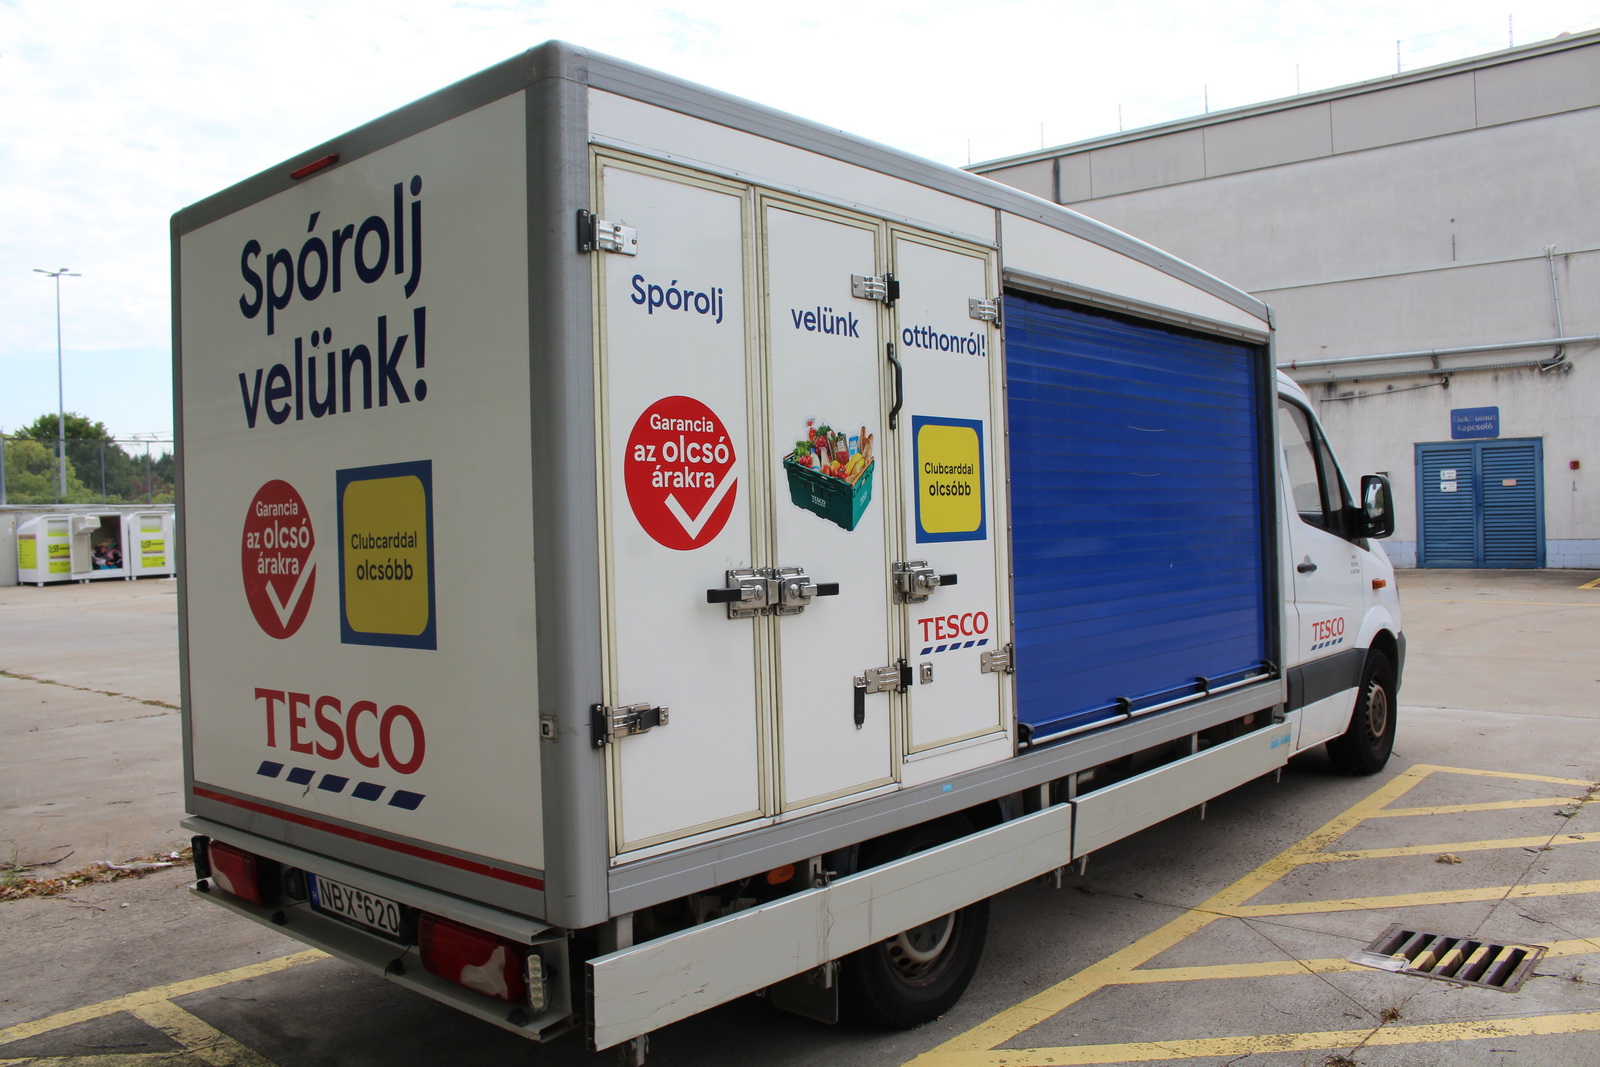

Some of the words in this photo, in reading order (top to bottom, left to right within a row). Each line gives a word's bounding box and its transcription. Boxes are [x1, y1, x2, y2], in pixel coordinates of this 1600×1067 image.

[239, 174, 423, 336] Spórolj
[630, 273, 724, 325] Spórolj
[790, 305, 860, 339] velünk
[902, 325, 986, 358] otthonról!
[238, 306, 427, 429] velünk!
[649, 413, 714, 433] Garancia
[633, 444, 657, 462] az
[662, 434, 730, 464] olcsó
[651, 464, 715, 488] árakra
[924, 461, 974, 475] Clubcarddal
[928, 480, 972, 497] olcsóbb
[255, 499, 299, 517] Garancia
[246, 531, 261, 549] az
[263, 518, 310, 549] olcsó
[351, 530, 417, 550] Clubcarddal
[257, 552, 300, 575] árakra
[356, 558, 414, 581] olcsóbb
[917, 610, 990, 643] TESCO
[1312, 616, 1345, 642] TESCO
[254, 687, 426, 775] TESCO
